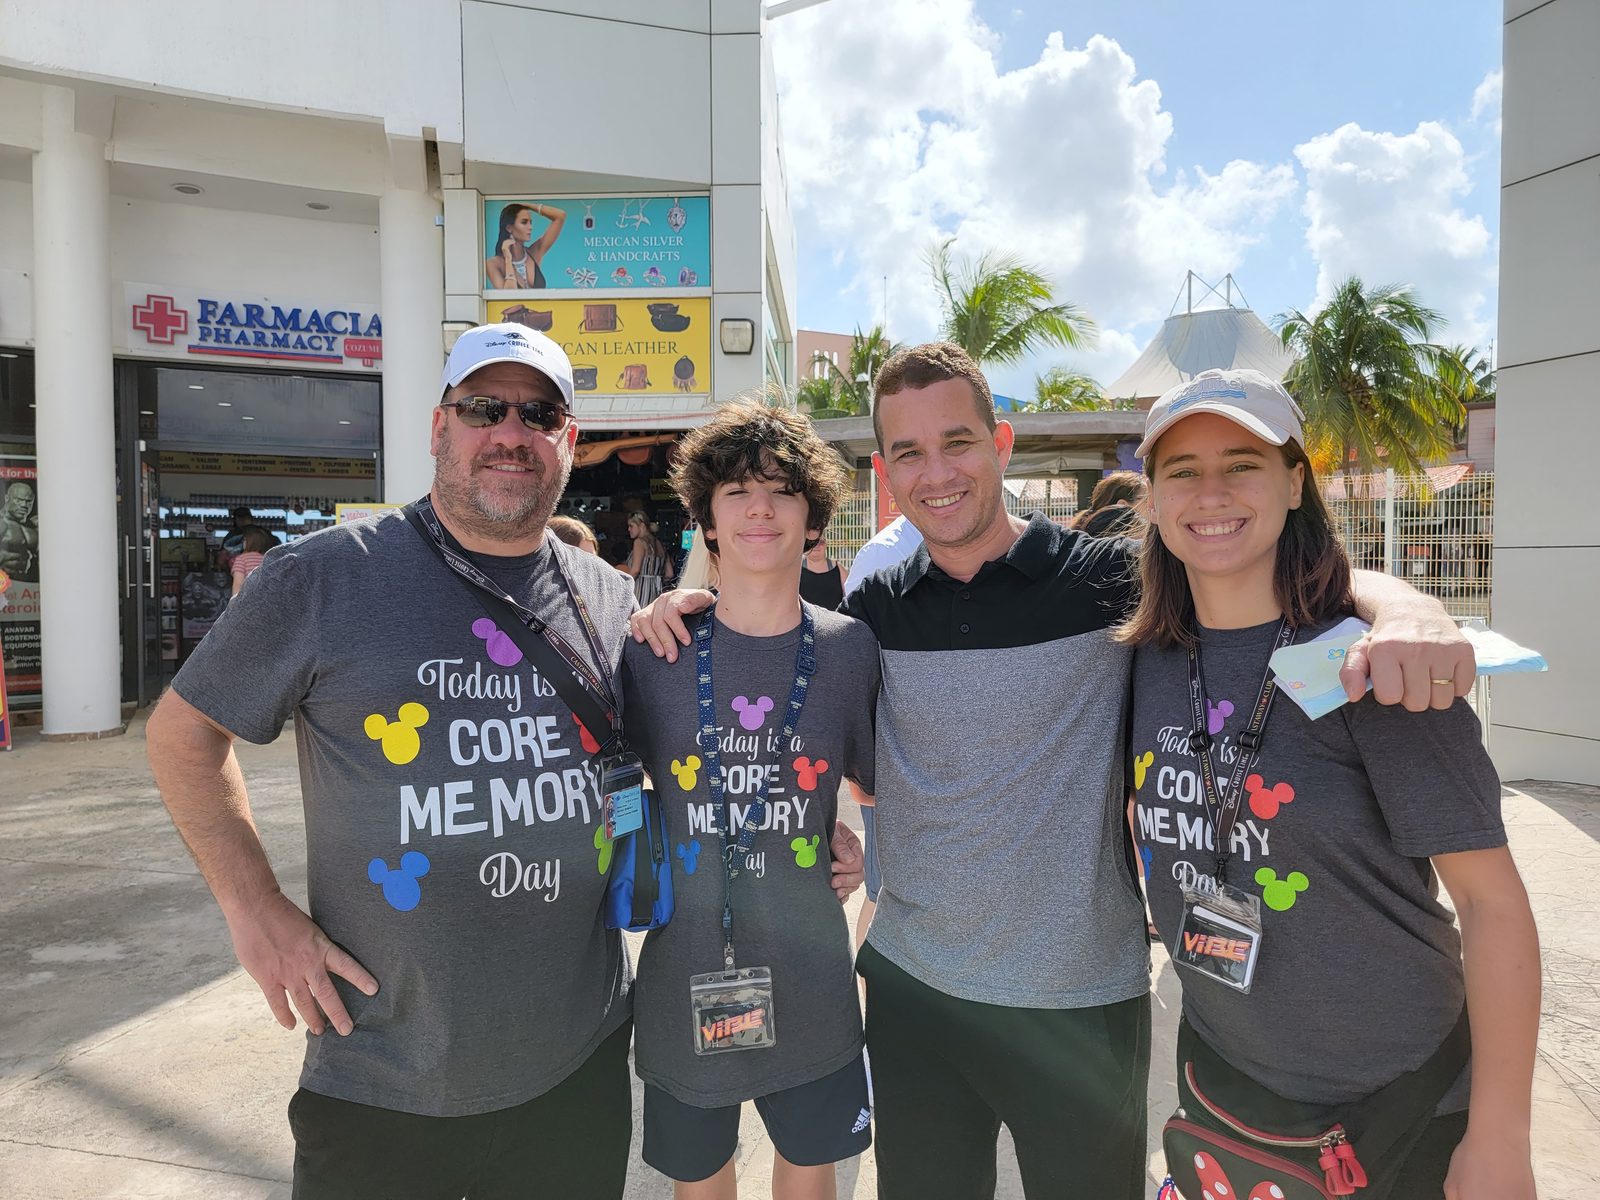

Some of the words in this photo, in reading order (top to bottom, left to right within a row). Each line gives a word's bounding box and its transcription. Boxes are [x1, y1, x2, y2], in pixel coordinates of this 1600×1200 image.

[584, 236, 640, 247] MEXICAN
[643, 236, 684, 247] SILVER
[587, 251, 598, 261] &
[600, 251, 681, 261] HANDCRAFTS
[197, 299, 382, 337] FARMACIA
[199, 325, 338, 351] PHARMACY
[604, 341, 678, 355] LEATHER
[417, 658, 522, 712] Today
[532, 666, 557, 698] is
[1251, 704, 1266, 732] STAWAY
[449, 716, 571, 767] CORE
[790, 735, 805, 753] a
[1220, 736, 1238, 765] is
[1199, 751, 1212, 780] ASTAWAY
[1206, 786, 1217, 805] CLUB
[1231, 767, 1244, 788] CRUISE
[1225, 788, 1240, 809] Disney
[479, 852, 561, 903] Day
